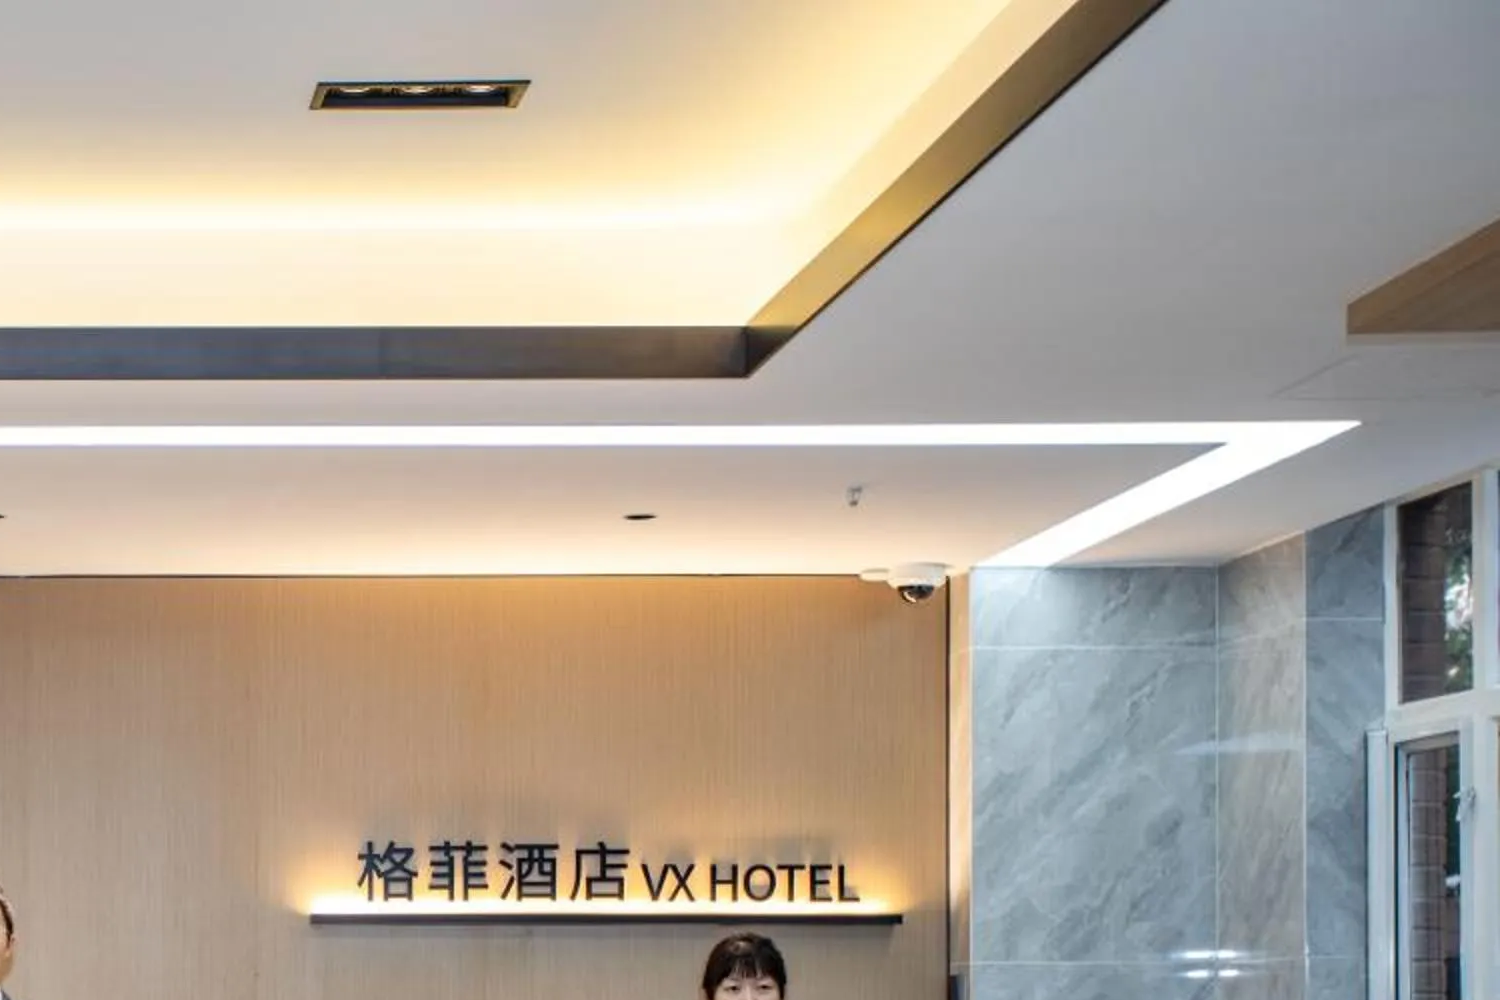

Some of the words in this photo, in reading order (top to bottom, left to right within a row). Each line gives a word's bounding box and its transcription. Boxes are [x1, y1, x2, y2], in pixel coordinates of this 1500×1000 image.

[357, 840, 631, 902] 格菲酒店
[641, 863, 696, 902] VX
[710, 863, 860, 902] HOTEL
